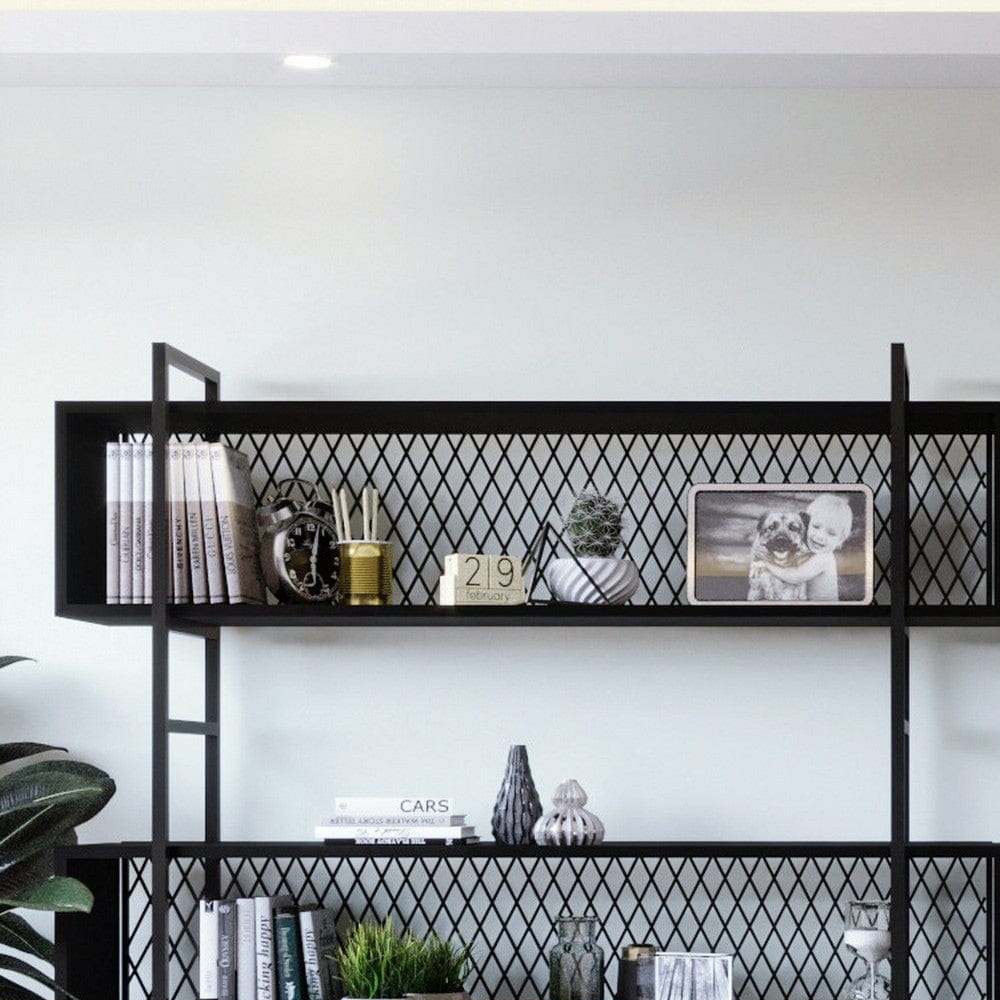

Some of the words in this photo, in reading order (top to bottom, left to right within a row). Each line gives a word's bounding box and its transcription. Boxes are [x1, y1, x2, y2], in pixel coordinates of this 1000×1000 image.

[466, 590, 511, 601] february
[400, 800, 449, 813] CARS
[257, 915, 272, 956] happy
